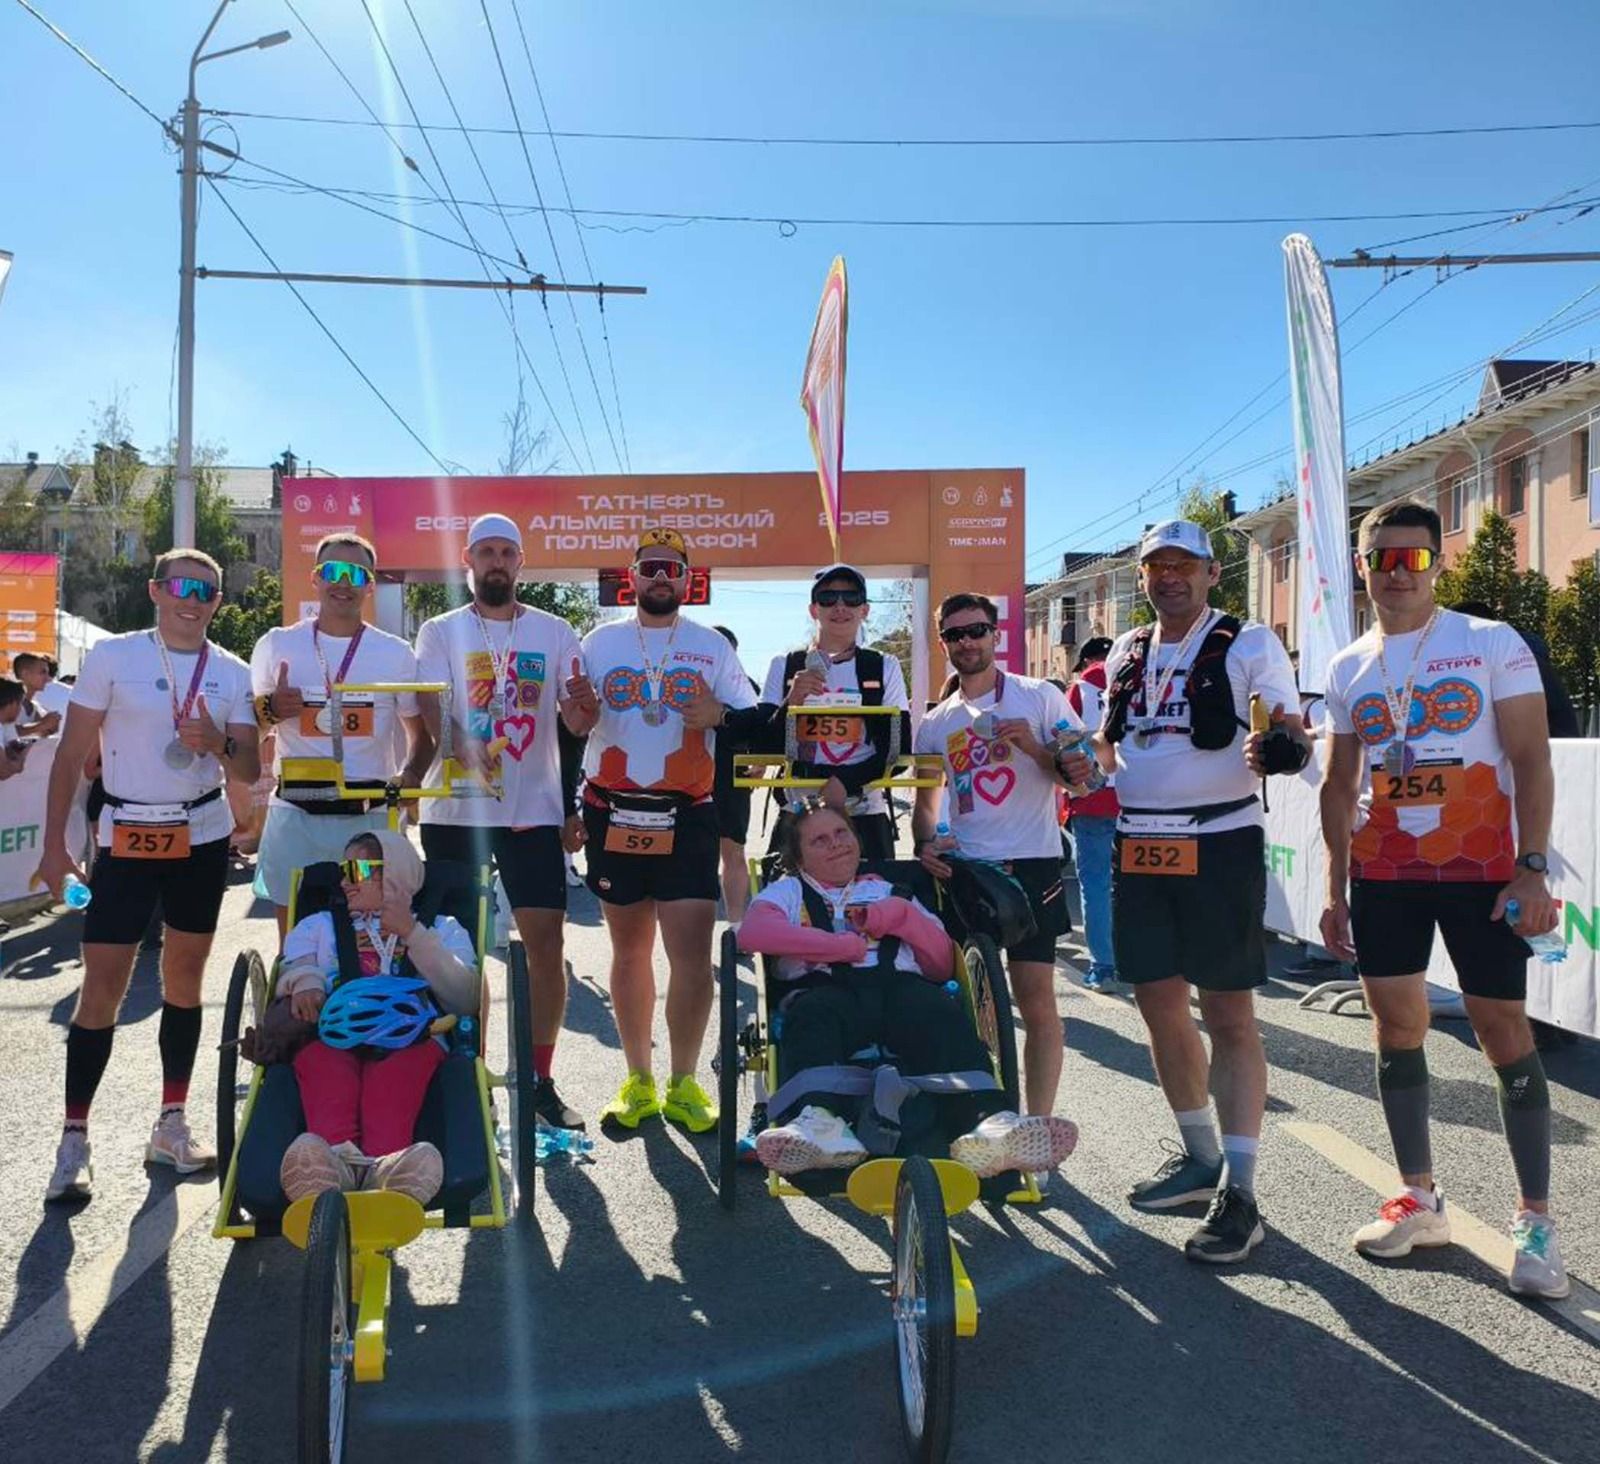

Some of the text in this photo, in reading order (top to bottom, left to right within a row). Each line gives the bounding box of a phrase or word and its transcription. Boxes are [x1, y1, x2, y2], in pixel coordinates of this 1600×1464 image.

[577, 494, 725, 510] ТАТНЕФТЬ
[528, 508, 775, 531] АЛЬМЕТЬЕВСКИЙ
[805, 715, 848, 737] 255
[1387, 773, 1447, 801] 254
[127, 831, 176, 853] 257
[625, 834, 655, 850] 59
[1133, 845, 1181, 868] 252
